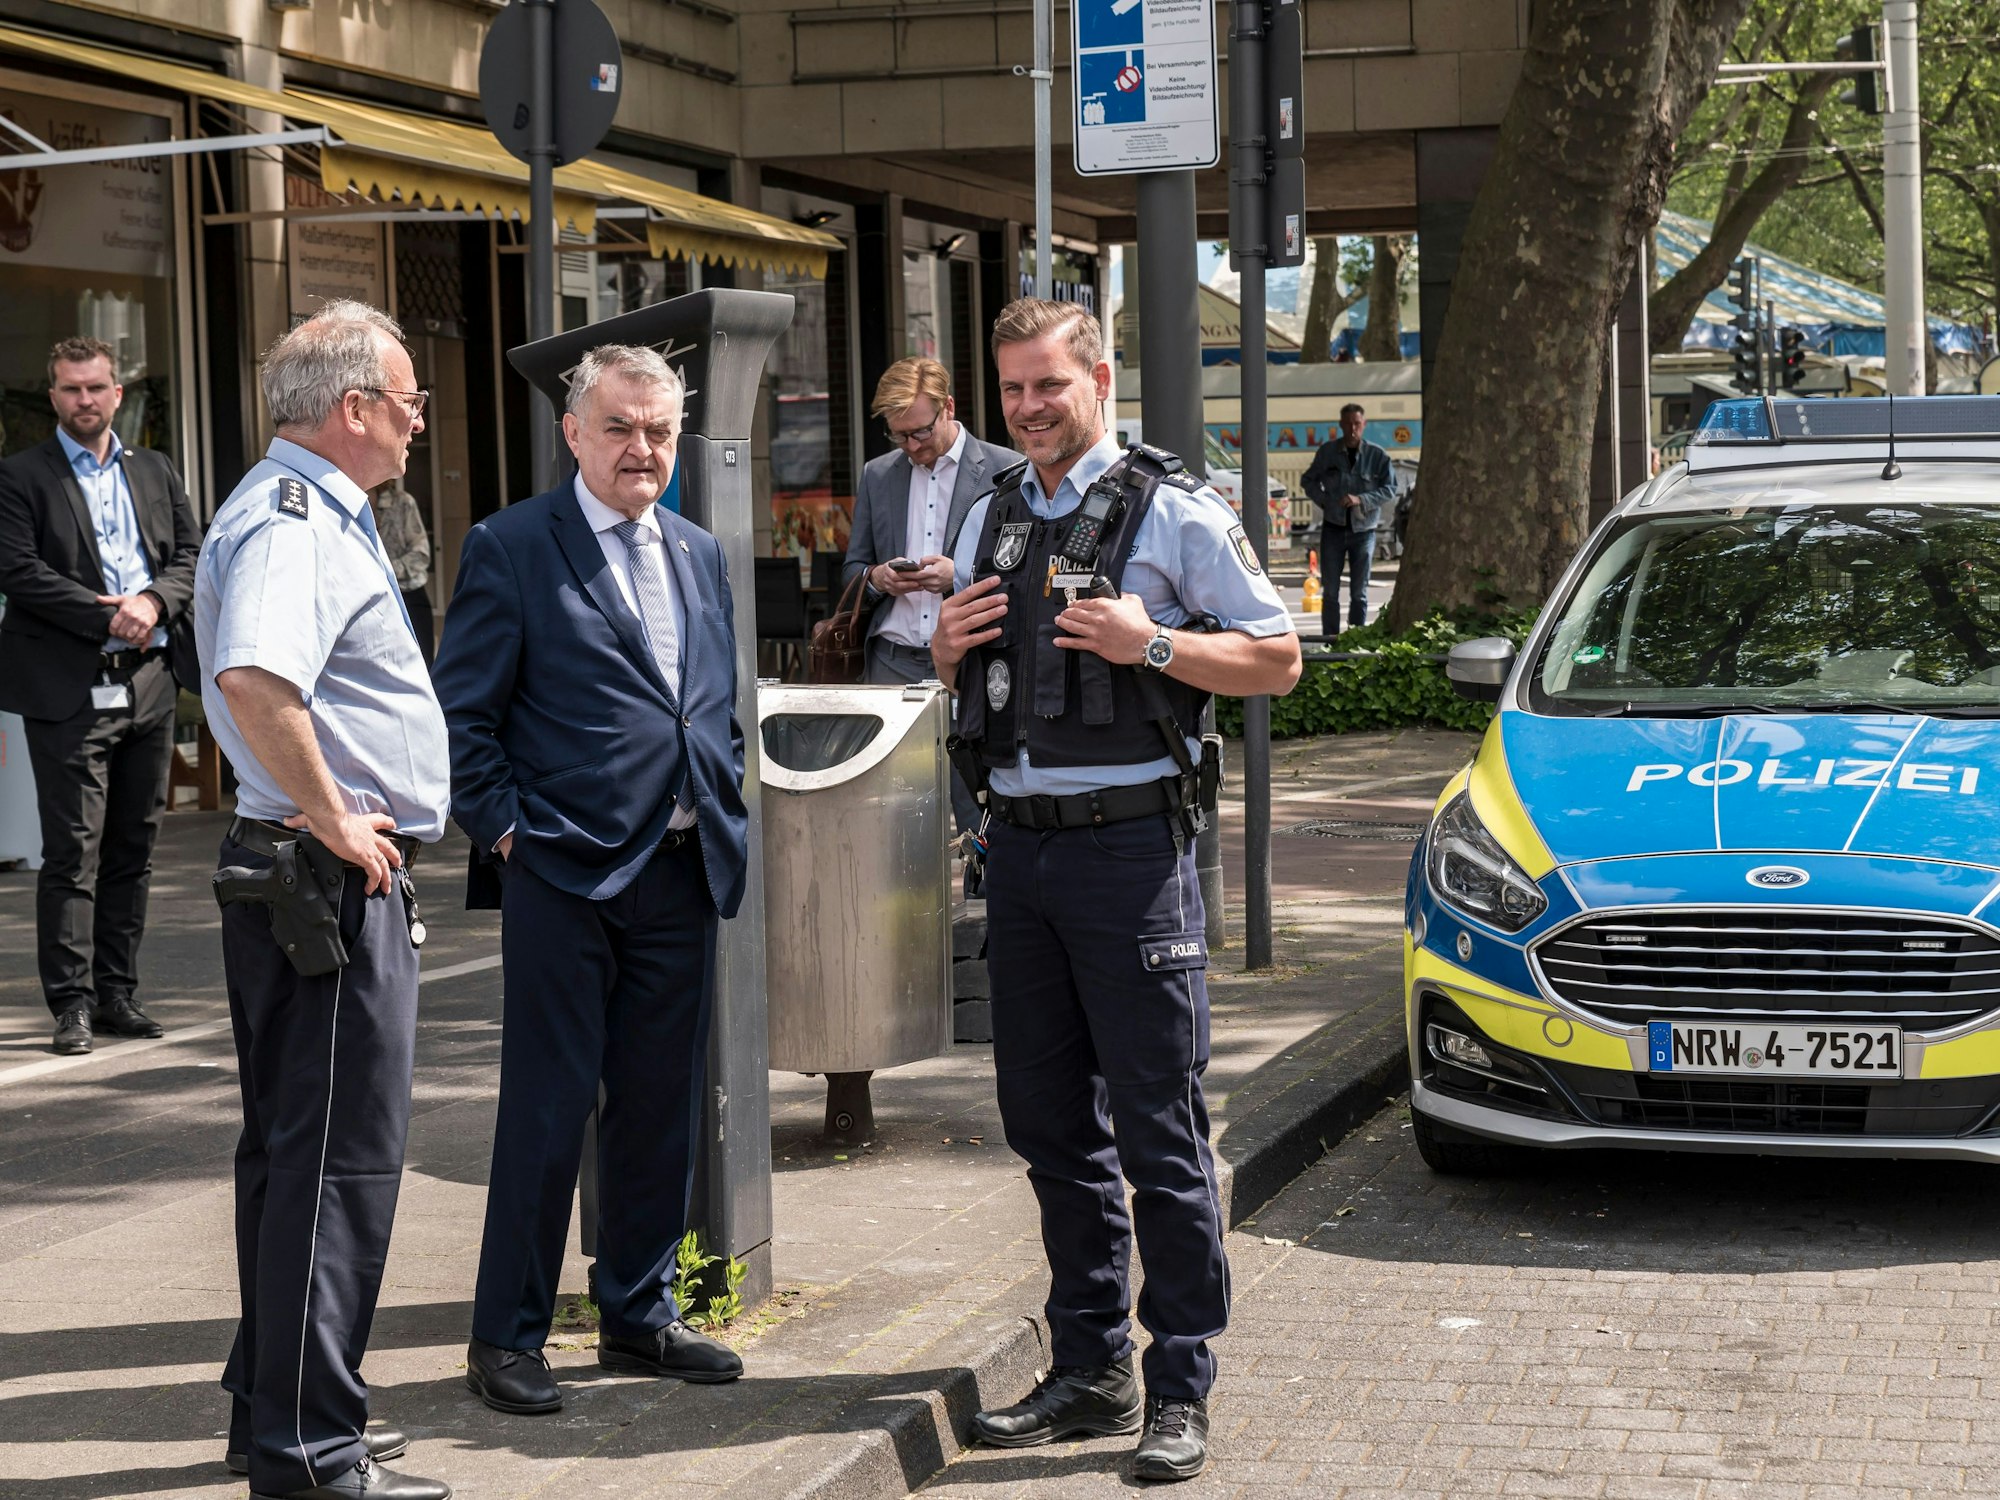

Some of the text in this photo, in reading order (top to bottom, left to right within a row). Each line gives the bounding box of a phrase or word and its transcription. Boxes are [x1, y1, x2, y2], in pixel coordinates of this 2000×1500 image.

[1150, 5, 1201, 14] Bildaufzeichnung
[1158, 60, 1207, 69] Versammlungen:
[1152, 92, 1204, 101] Bildaufzeichnung
[725, 450, 736, 463] 973
[1003, 525, 1028, 535] POLIZEI
[1055, 577, 1090, 585] Schwarzer
[1626, 759, 1980, 795] POLIZEI
[1762, 872, 1793, 883] Ford
[1170, 942, 1201, 958] POLIZEI
[1672, 1028, 1897, 1070] NRW 4-7521
[1656, 1052, 1666, 1062] D
